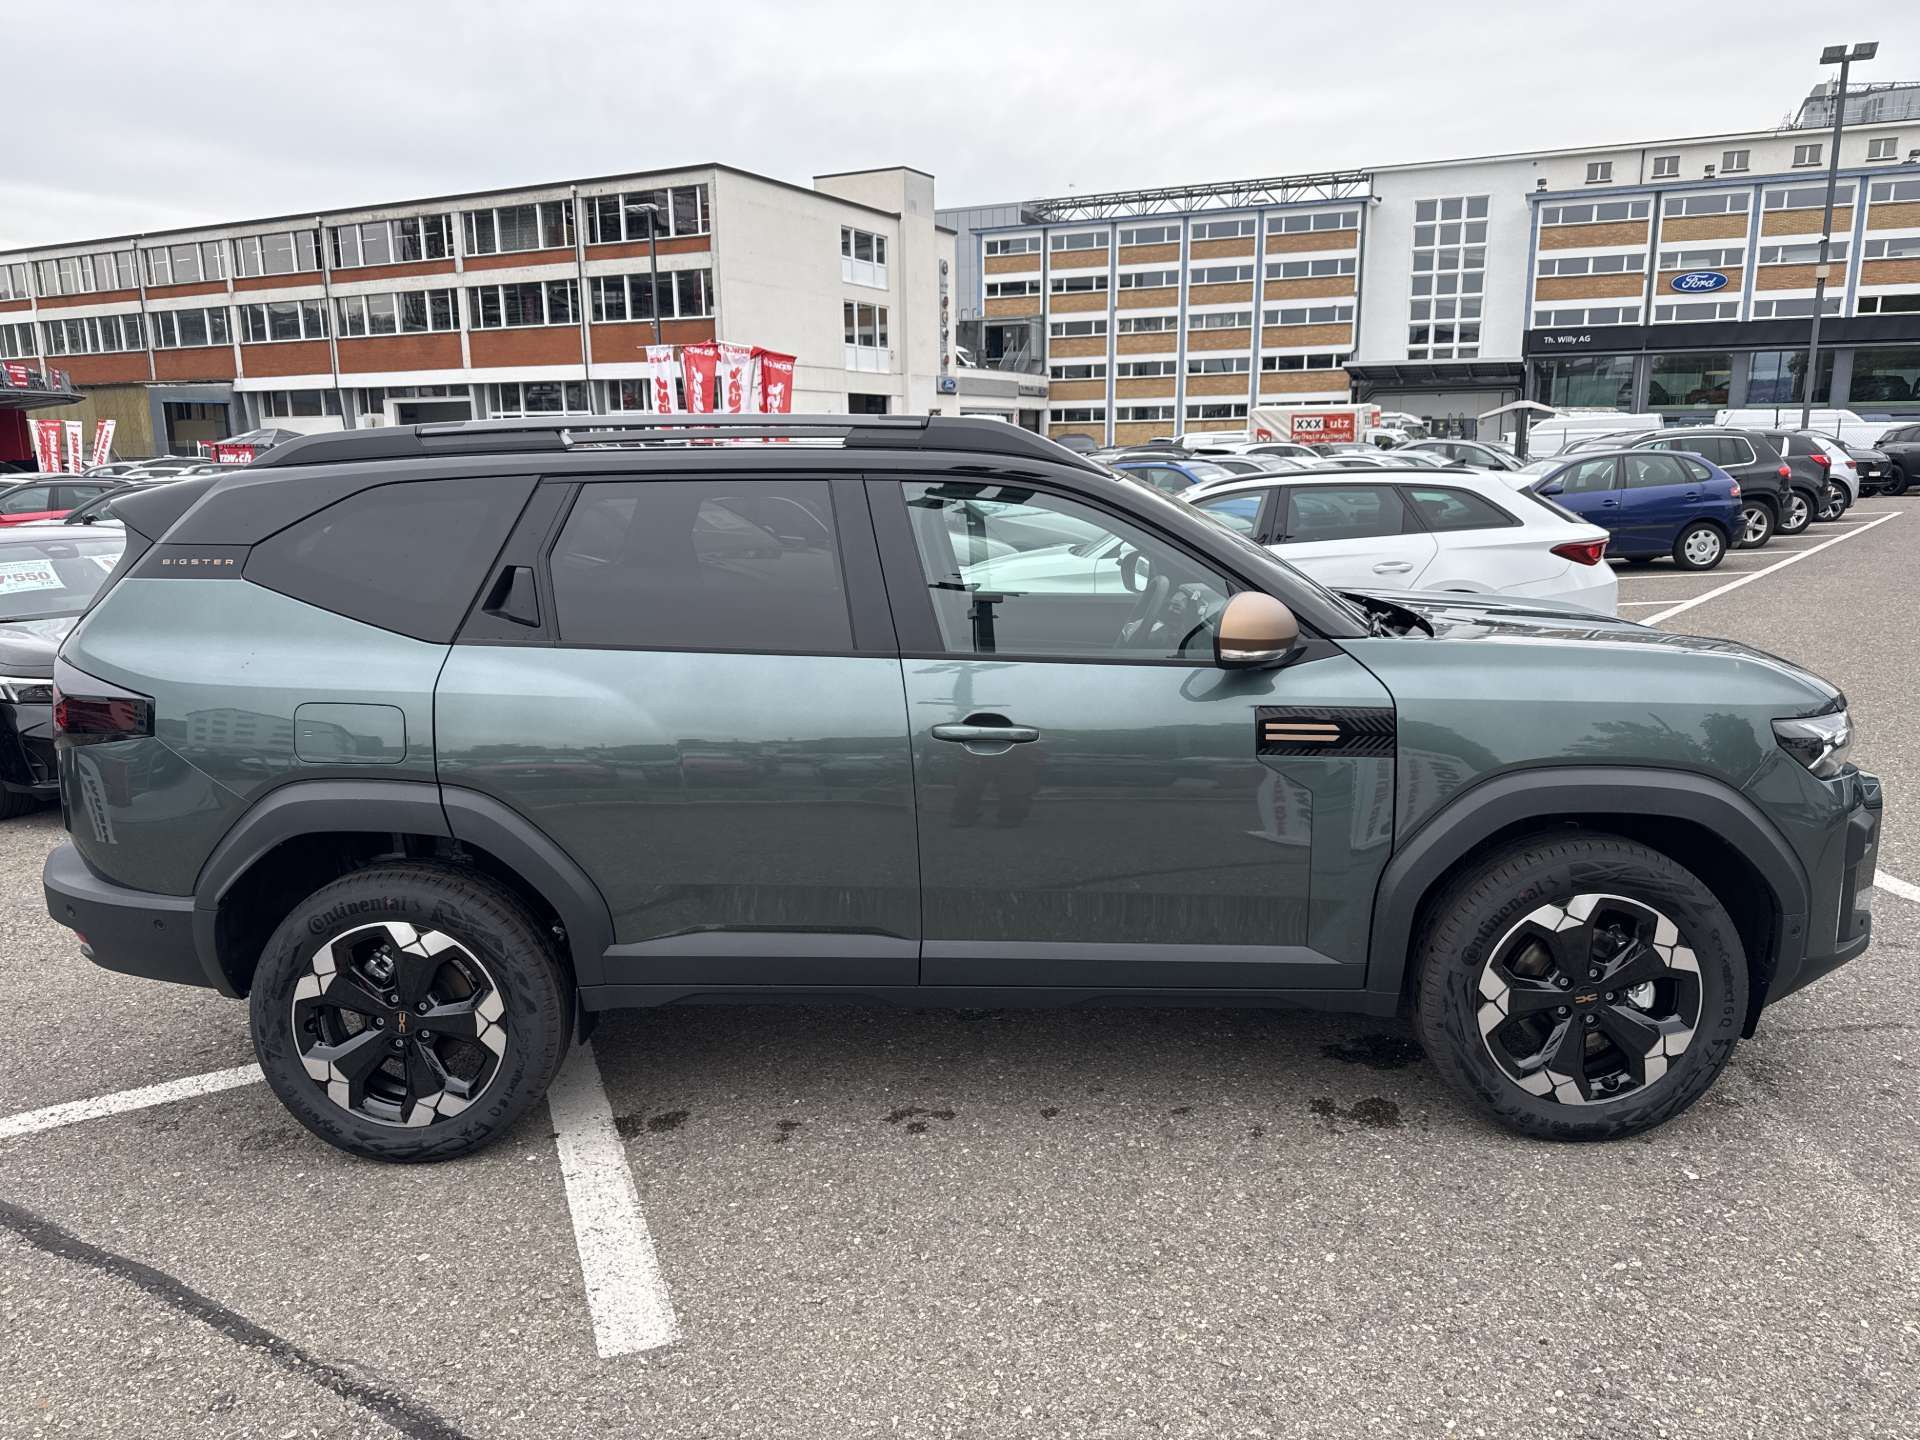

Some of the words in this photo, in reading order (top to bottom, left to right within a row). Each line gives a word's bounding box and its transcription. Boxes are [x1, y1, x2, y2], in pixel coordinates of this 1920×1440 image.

[1681, 274, 1717, 288] Ford
[1543, 336, 1555, 344] Th.
[1557, 335, 1577, 345] Willy
[1578, 334, 1591, 343] AG
[308, 896, 407, 935] Continental
[1461, 881, 1544, 966] Continental
